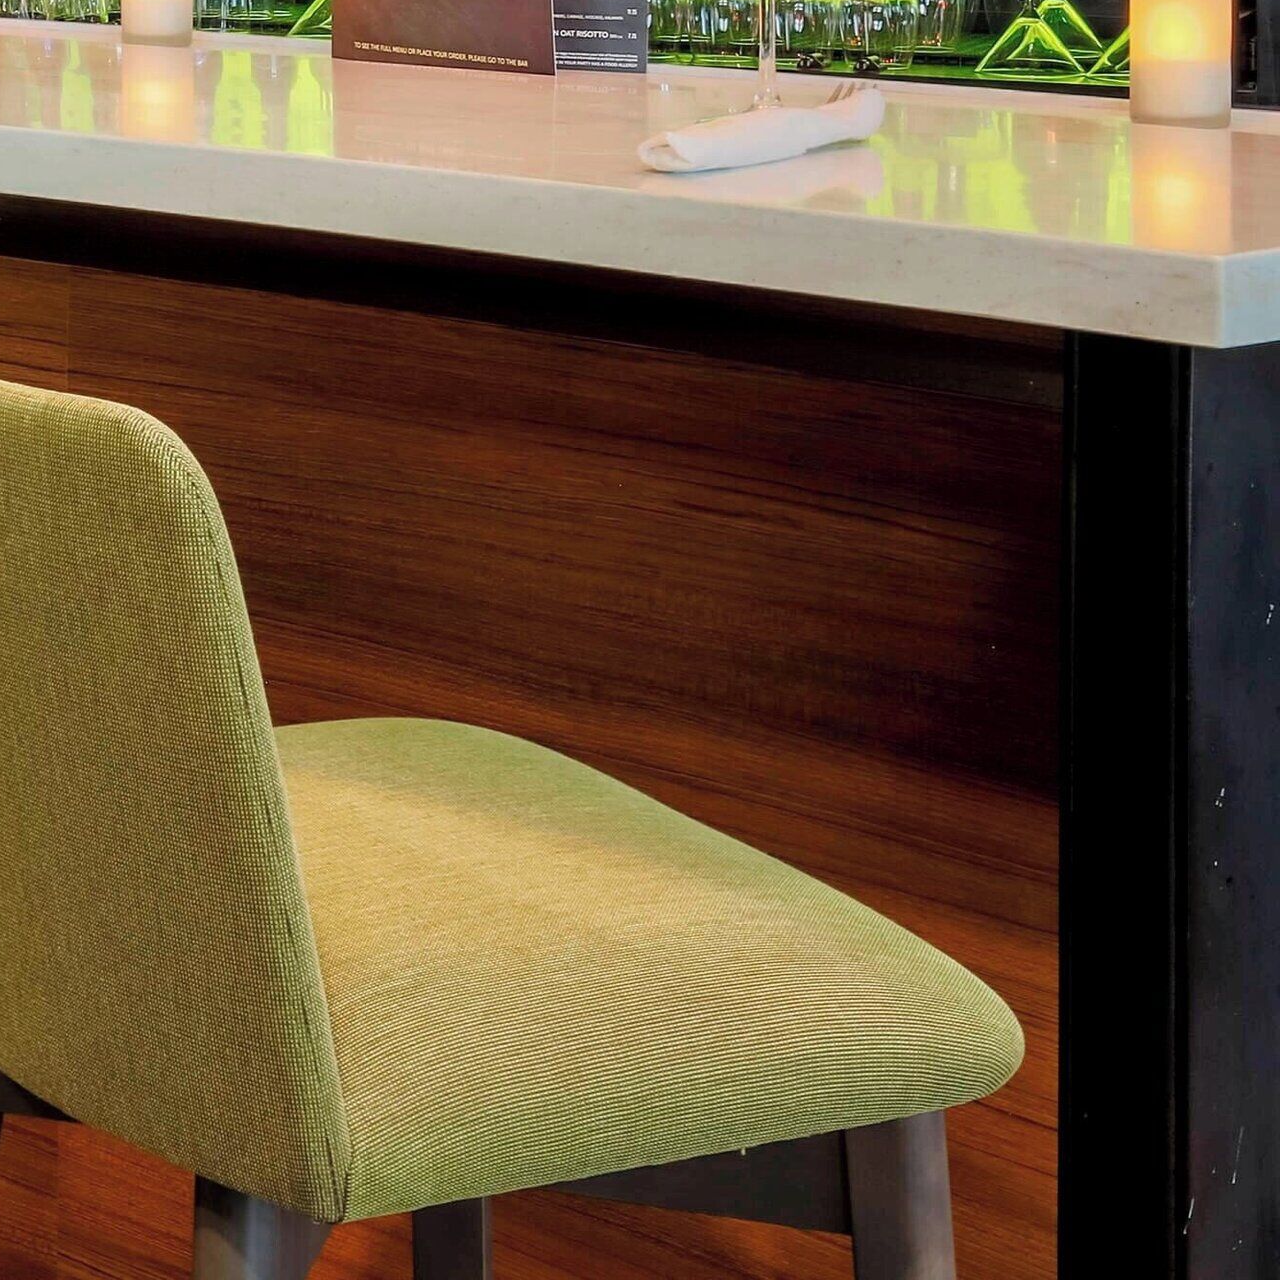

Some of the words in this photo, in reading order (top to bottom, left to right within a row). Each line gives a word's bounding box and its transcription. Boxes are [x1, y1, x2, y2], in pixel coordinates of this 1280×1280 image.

[560, 30, 576, 38] OAT
[576, 30, 609, 39] RISOTTO
[370, 43, 380, 51] THE
[380, 44, 392, 53] FULL
[392, 46, 408, 55] MENU
[407, 47, 416, 56] OR
[416, 48, 432, 57] PLACE
[432, 50, 448, 59] YOUR
[467, 53, 487, 63] PLEASE
[487, 56, 496, 64] GO
[496, 57, 505, 65] TO
[505, 58, 517, 66] THE
[516, 59, 528, 68] BAR
